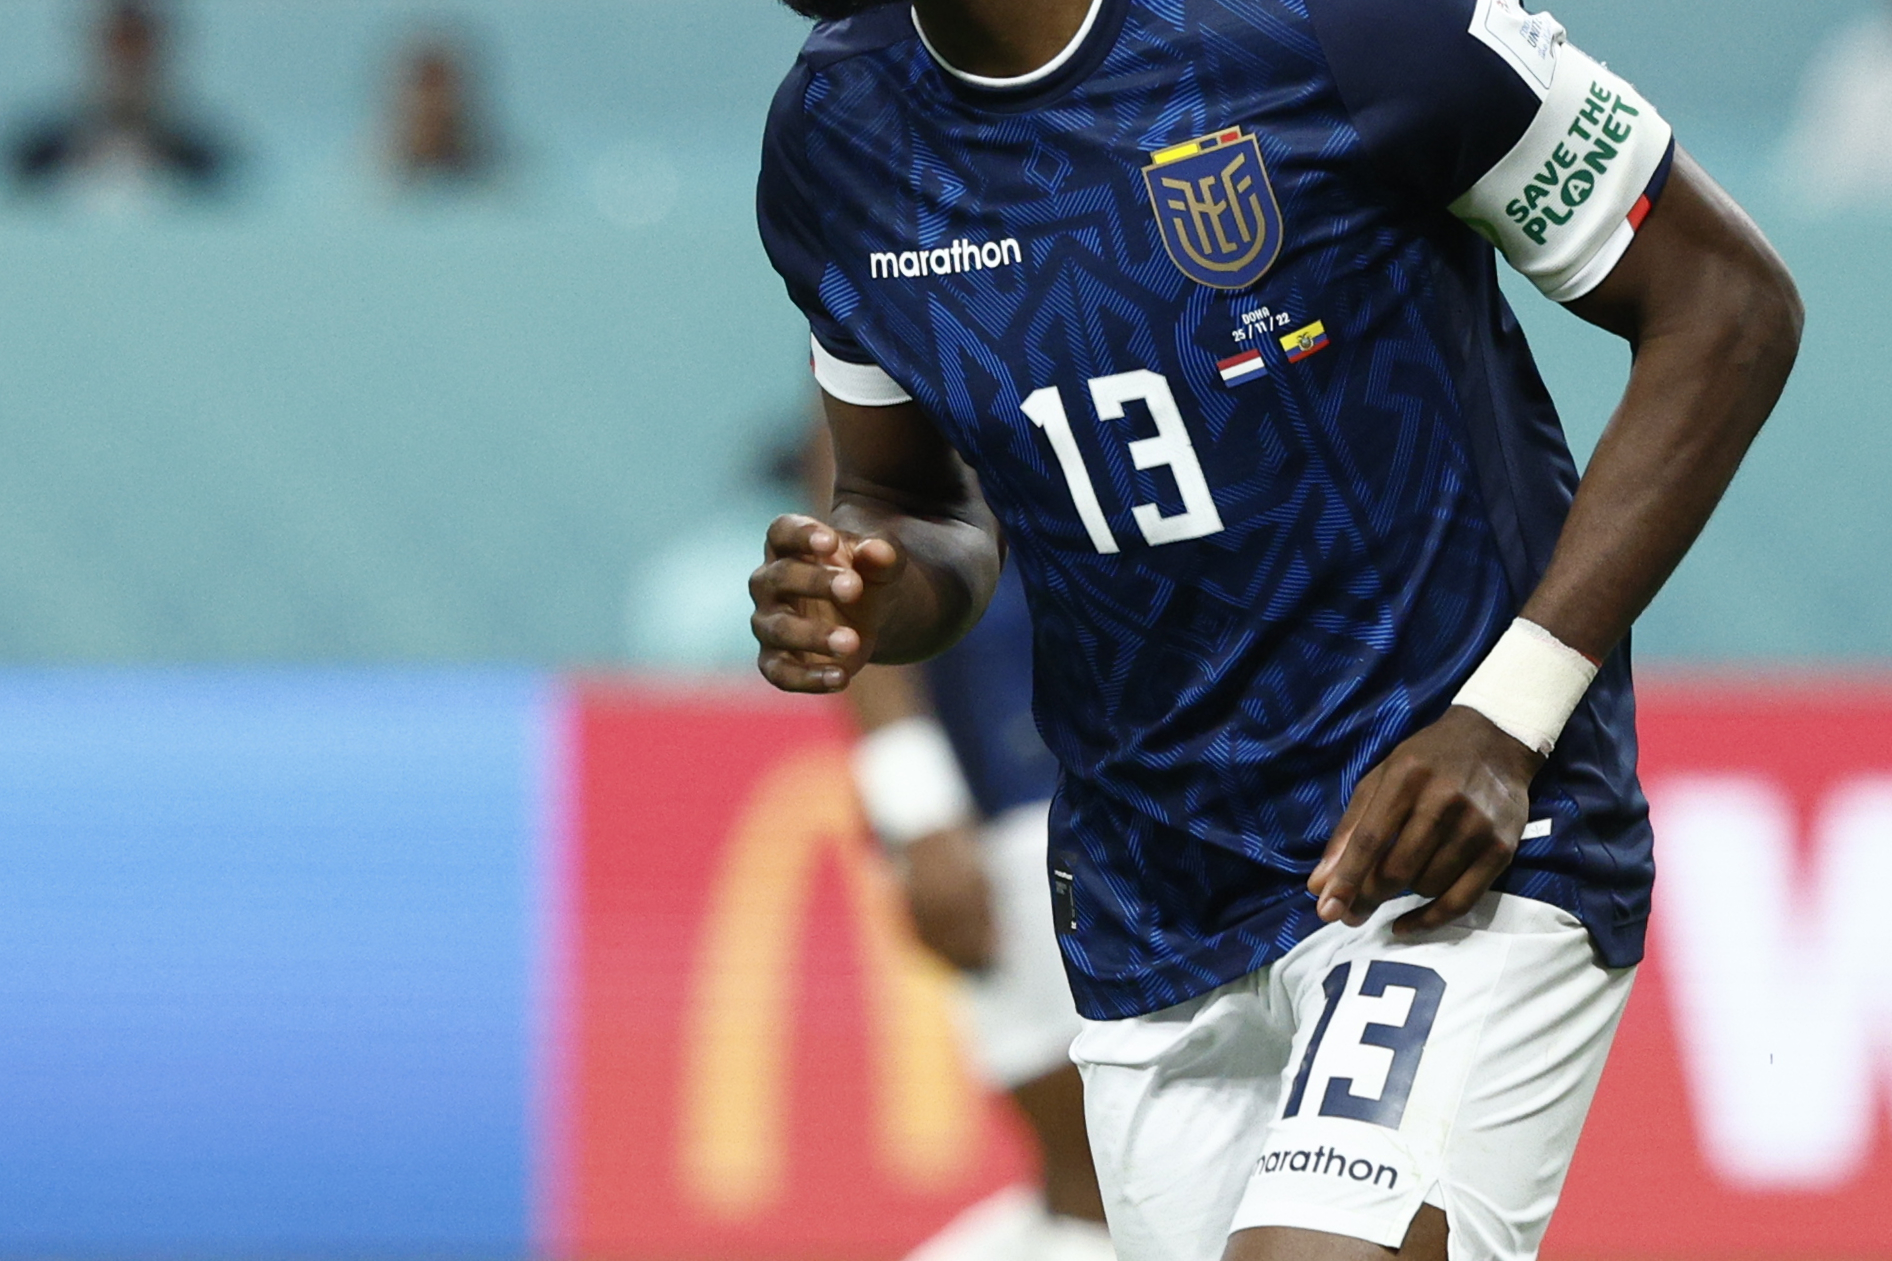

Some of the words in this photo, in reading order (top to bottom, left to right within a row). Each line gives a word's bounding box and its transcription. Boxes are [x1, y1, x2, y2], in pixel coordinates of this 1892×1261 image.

[1505, 141, 1578, 224] SAVE
[1567, 80, 1612, 141] THE
[1522, 94, 1639, 246] PLANET
[869, 237, 1023, 279] marathon
[1241, 306, 1270, 324] DOHA
[1018, 367, 1226, 555] 13
[1281, 958, 1448, 1131] 13
